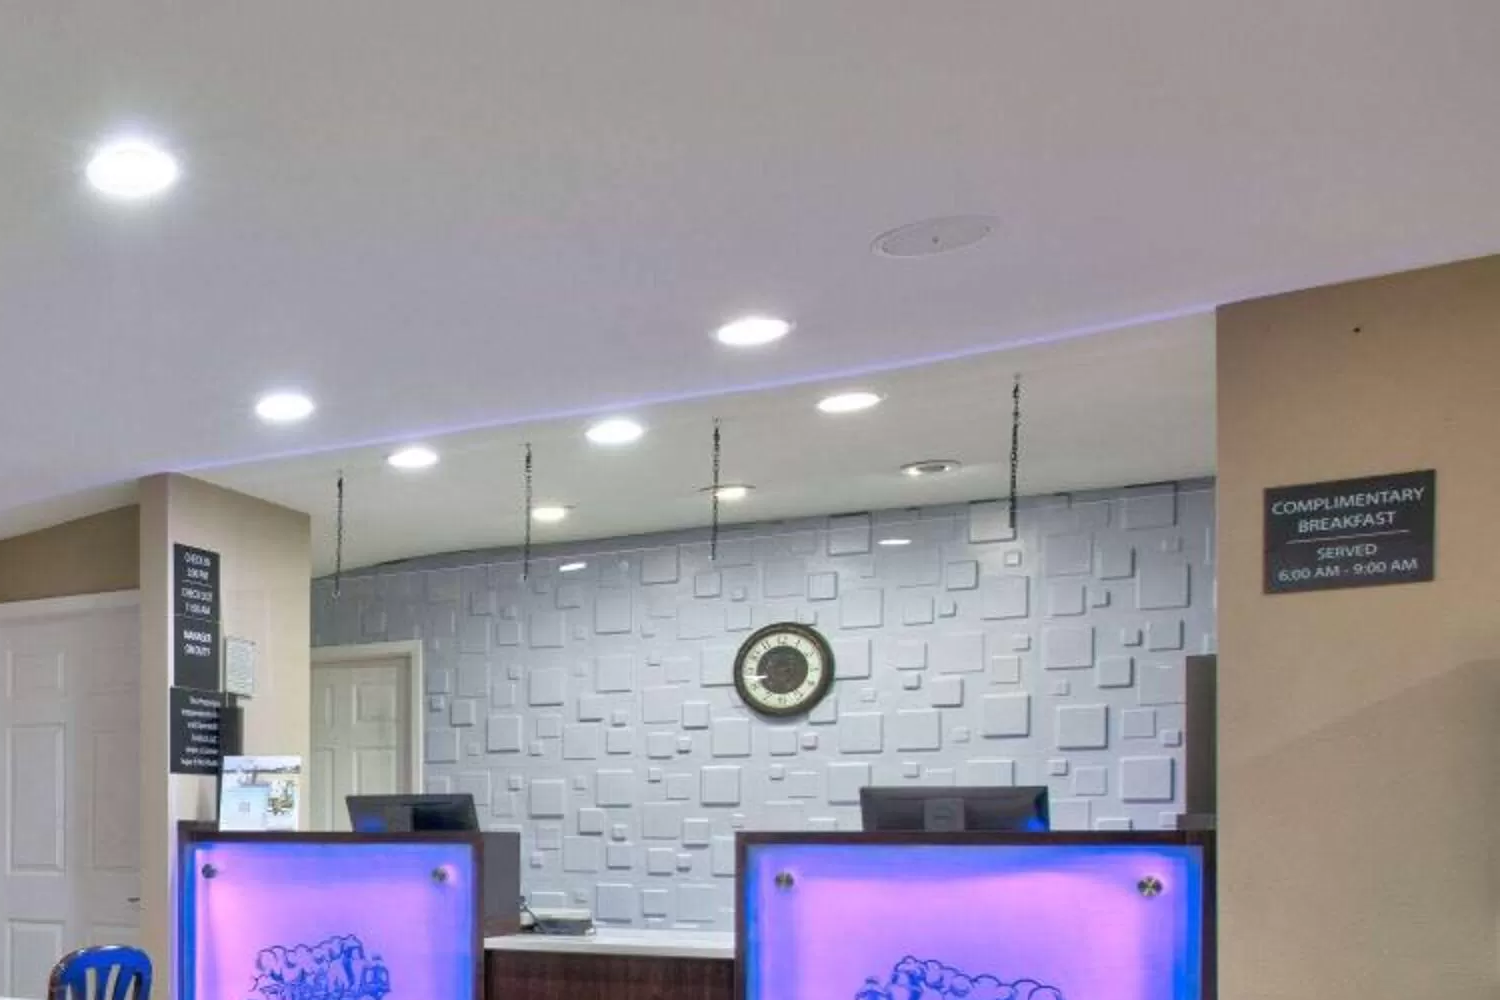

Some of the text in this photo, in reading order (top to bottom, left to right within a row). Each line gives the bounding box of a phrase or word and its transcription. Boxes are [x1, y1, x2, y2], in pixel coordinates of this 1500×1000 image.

[1272, 487, 1425, 515] COMPLIMENTARY
[1298, 511, 1397, 533] BREAKFAST
[1316, 543, 1378, 561] SERVED
[1278, 567, 1312, 582] 6:00
[1313, 565, 1341, 579] AM
[1352, 561, 1387, 576] 9:00
[1390, 557, 1419, 573] AM
